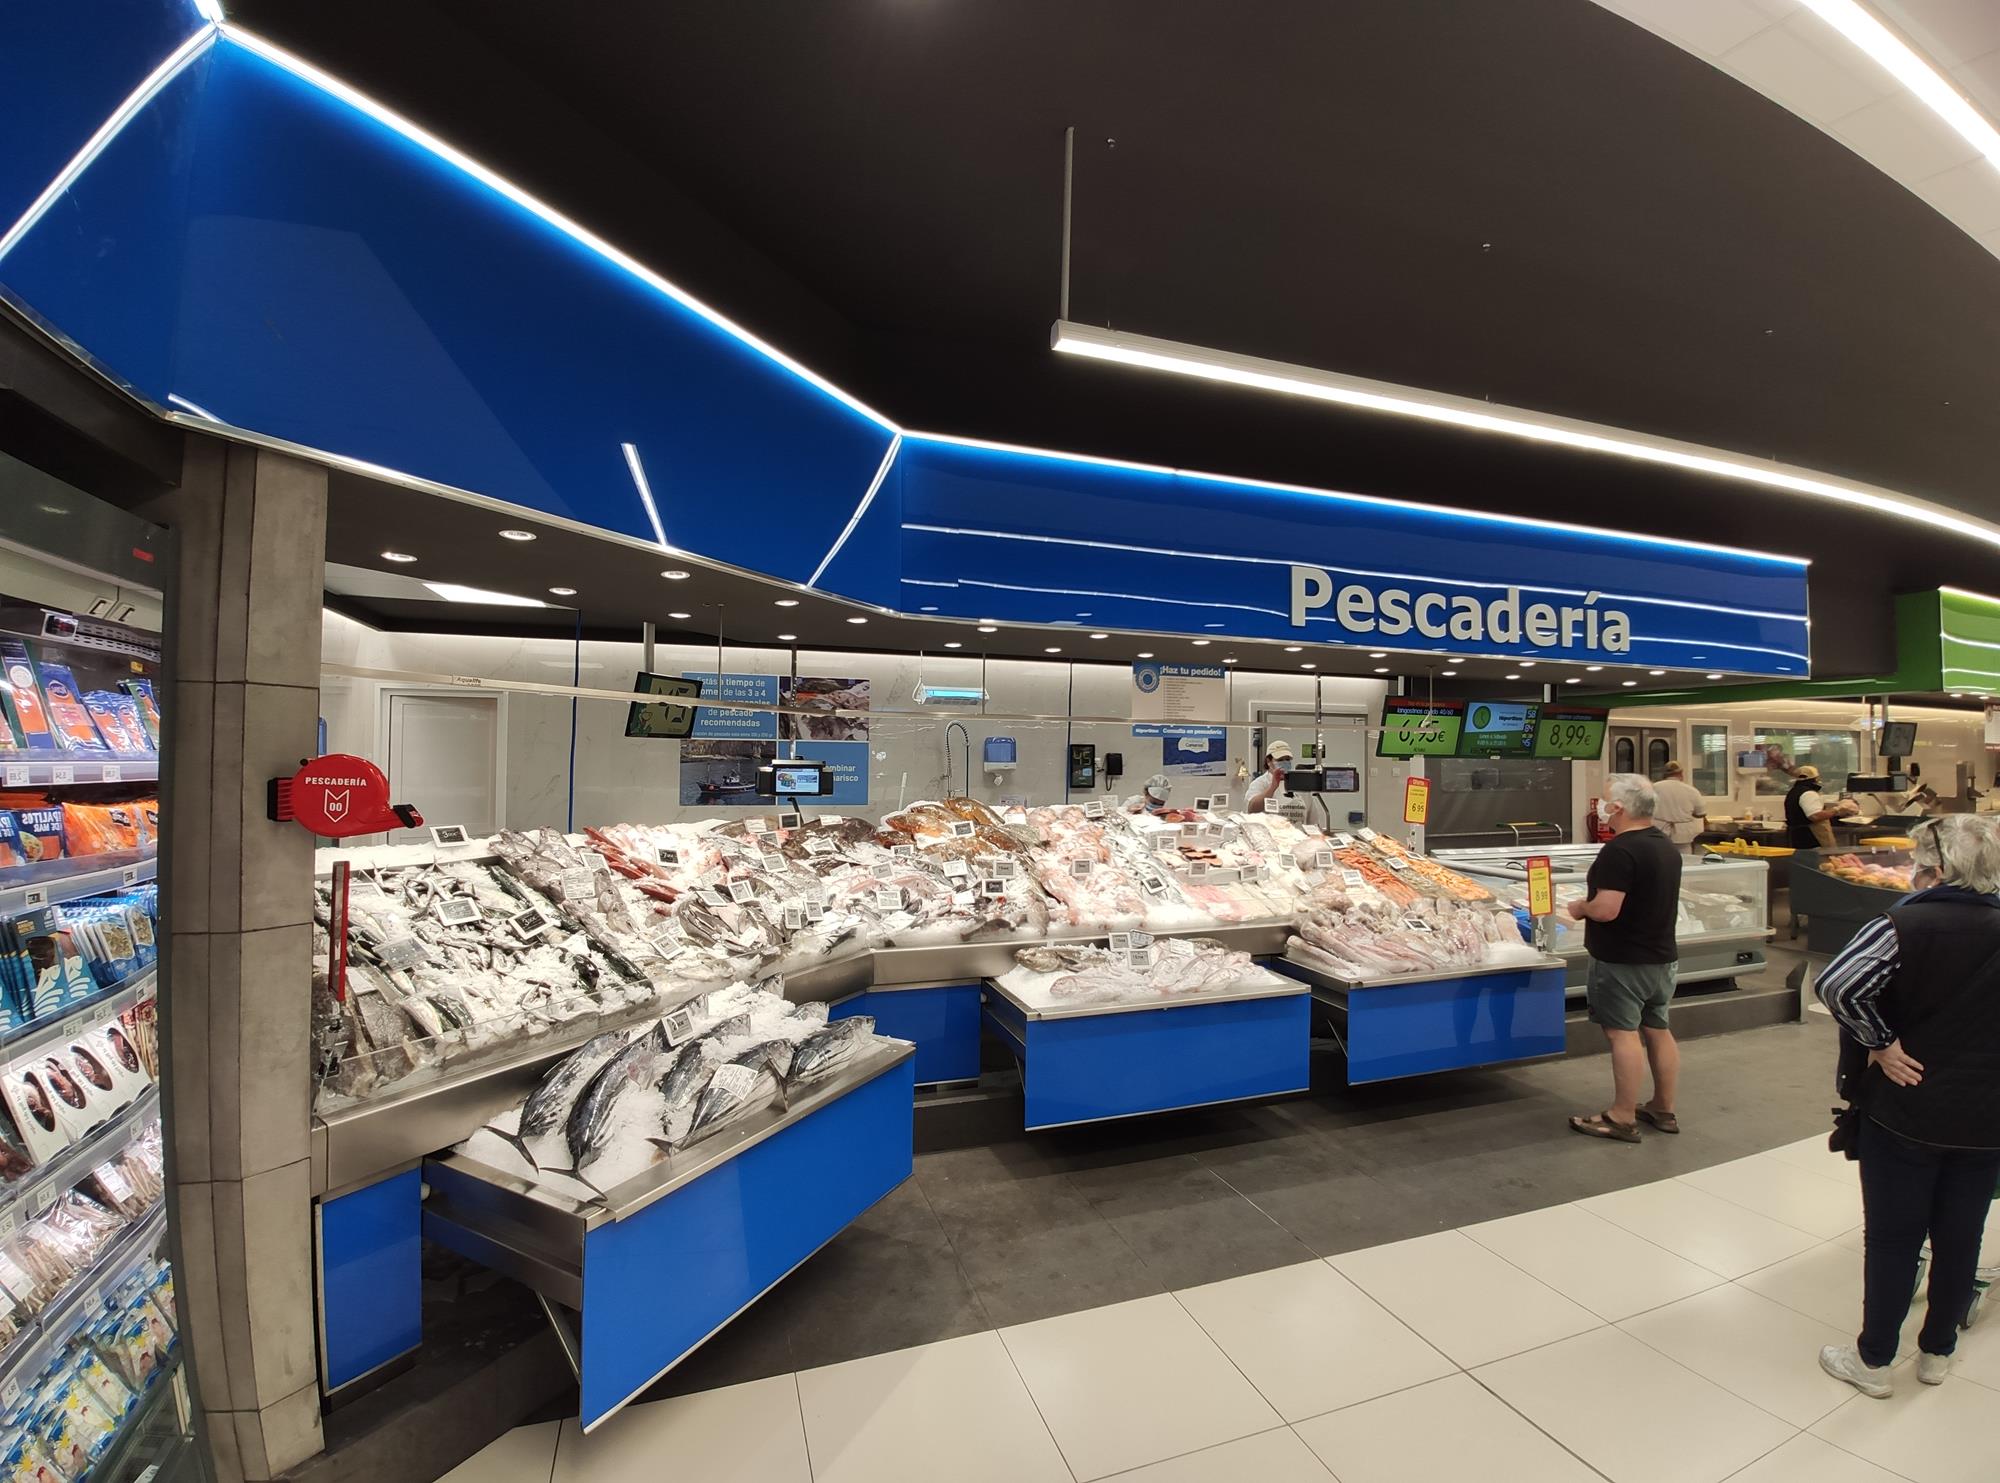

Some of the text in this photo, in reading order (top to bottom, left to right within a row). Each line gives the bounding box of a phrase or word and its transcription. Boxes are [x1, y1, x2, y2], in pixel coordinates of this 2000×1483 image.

[1290, 565, 1631, 652] Pescadería
[1180, 667, 1189, 675] tu
[1191, 668, 1221, 677] pedido!
[698, 677, 718, 686] stás
[726, 677, 754, 688] tiempo
[756, 679, 765, 687] de
[735, 689, 746, 697] las
[720, 709, 754, 717] pescado
[700, 719, 761, 727] recomendadas
[305, 777, 367, 787] PESCADERÍA
[329, 802, 342, 812] 00
